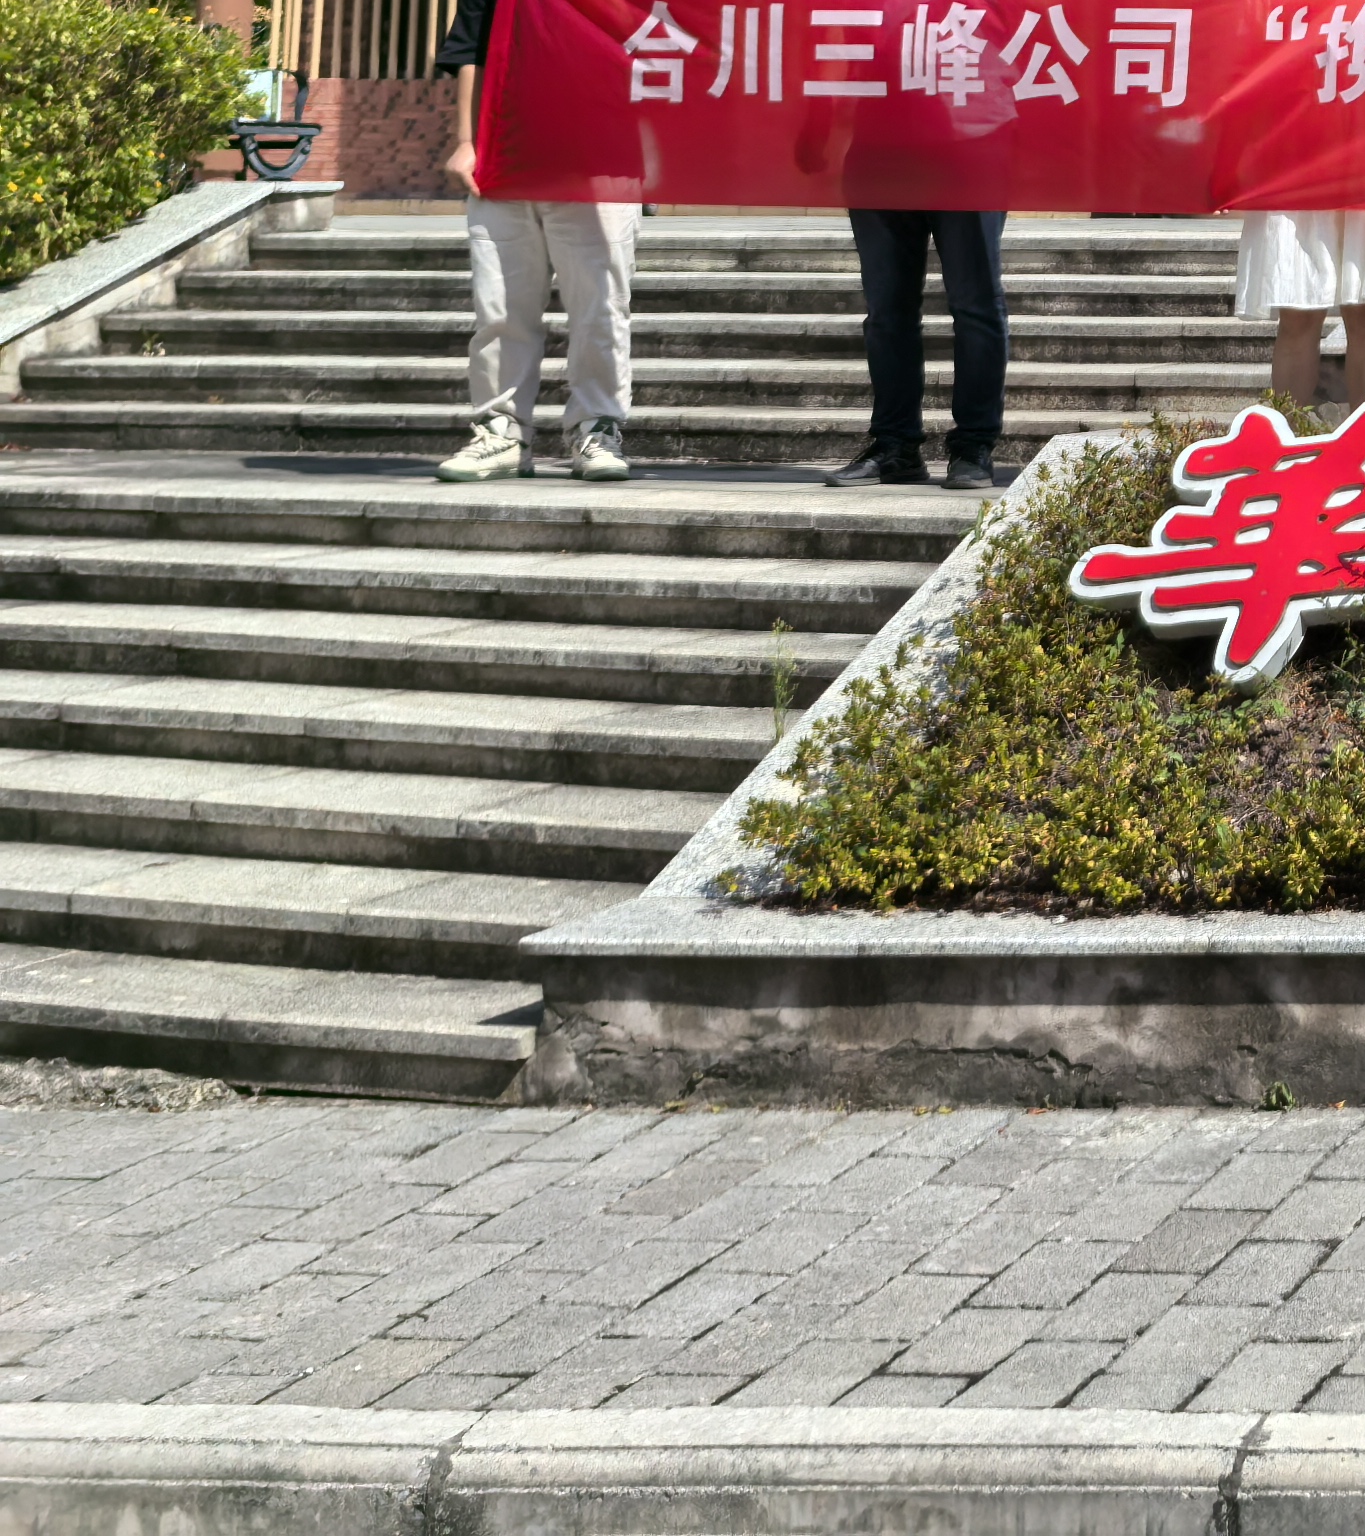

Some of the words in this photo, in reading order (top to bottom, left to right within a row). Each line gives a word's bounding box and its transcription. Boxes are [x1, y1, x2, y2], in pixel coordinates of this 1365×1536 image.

[624, 0, 1194, 107] 合川三峰公司
